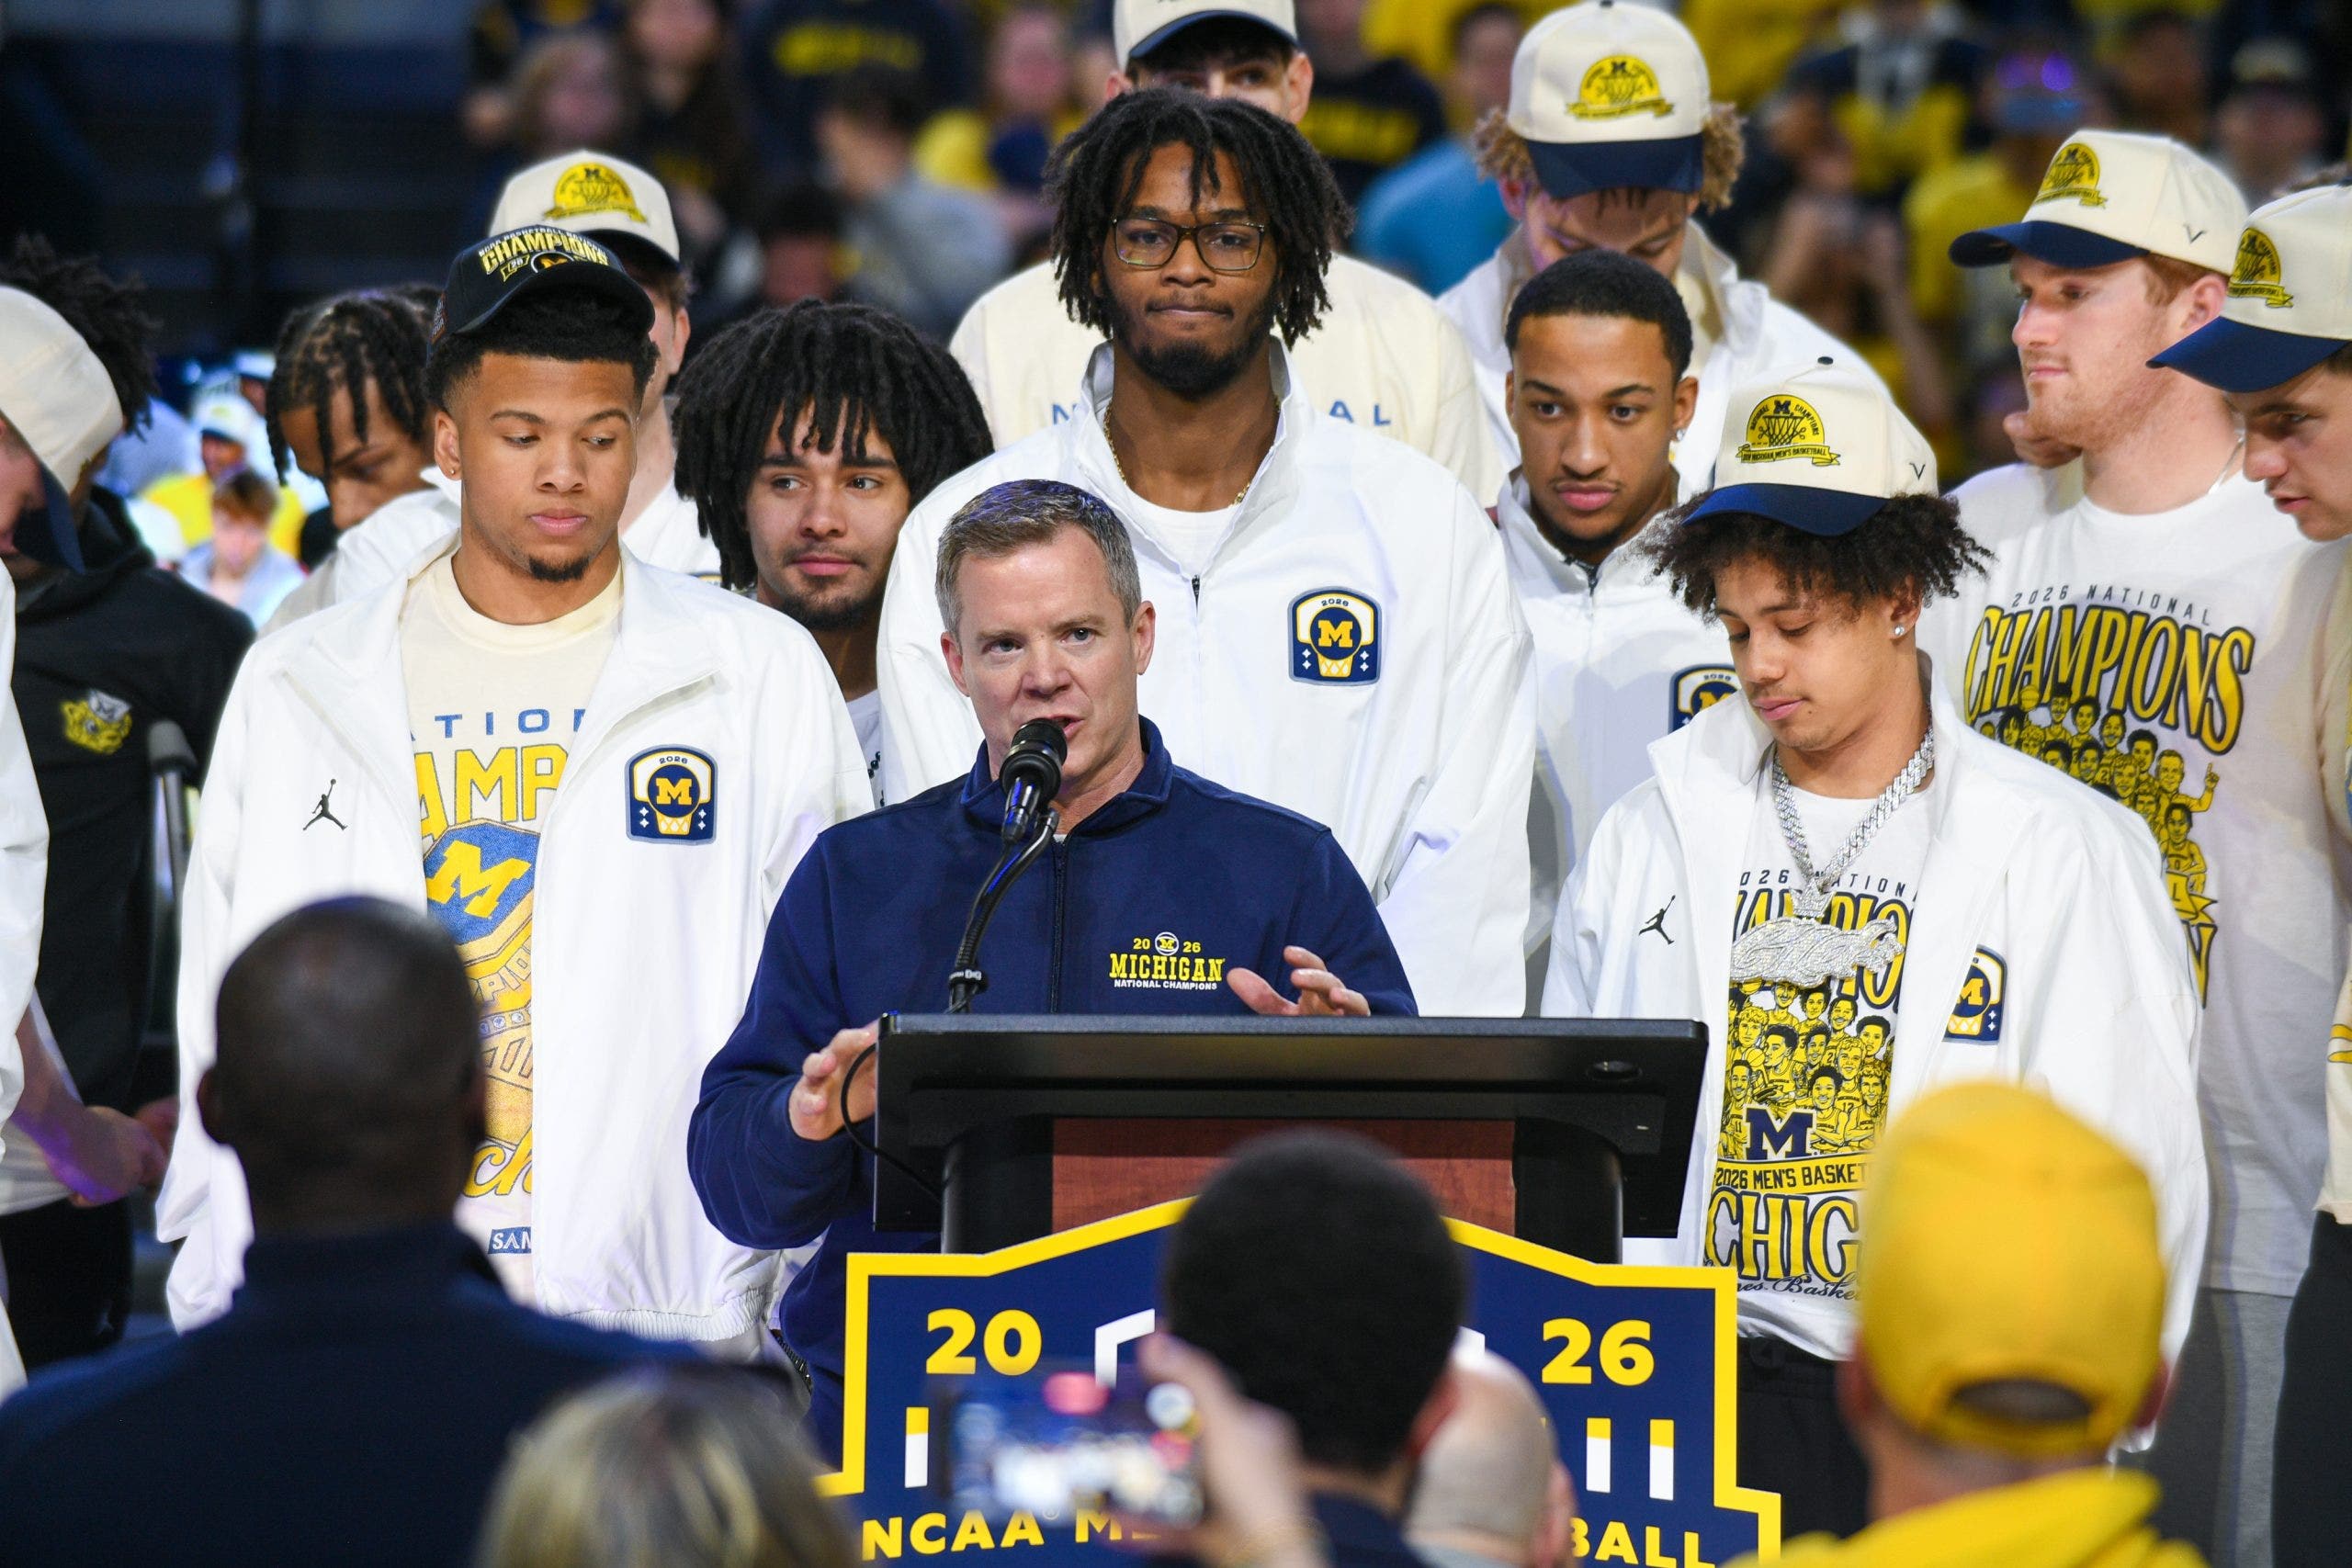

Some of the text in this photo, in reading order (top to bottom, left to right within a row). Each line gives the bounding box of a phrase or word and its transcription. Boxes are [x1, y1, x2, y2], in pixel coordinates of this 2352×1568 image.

[481, 231, 610, 275] CHAMPIONS
[1773, 400, 1792, 414] M
[1320, 598, 1349, 606] 2026
[2011, 584, 2211, 626] 2026 NATIONAL
[1317, 619, 1353, 648] M
[1962, 604, 2256, 756] CHAMPIONS
[411, 708, 586, 741] TIO
[659, 756, 688, 764] 2026
[655, 777, 693, 806] M
[426, 840, 532, 919] M
[1133, 938, 1202, 953] 20 M 26
[1109, 953, 1223, 982] MICHIGAN
[1114, 979, 1217, 991] NATIONAL CHAMPIONS
[1746, 1107, 1815, 1160] M
[1715, 1167, 1748, 1190] 2026
[1753, 1168, 1797, 1190] MEN'S
[926, 1308, 1043, 1377] 20
[1541, 1317, 1655, 1387] 26
